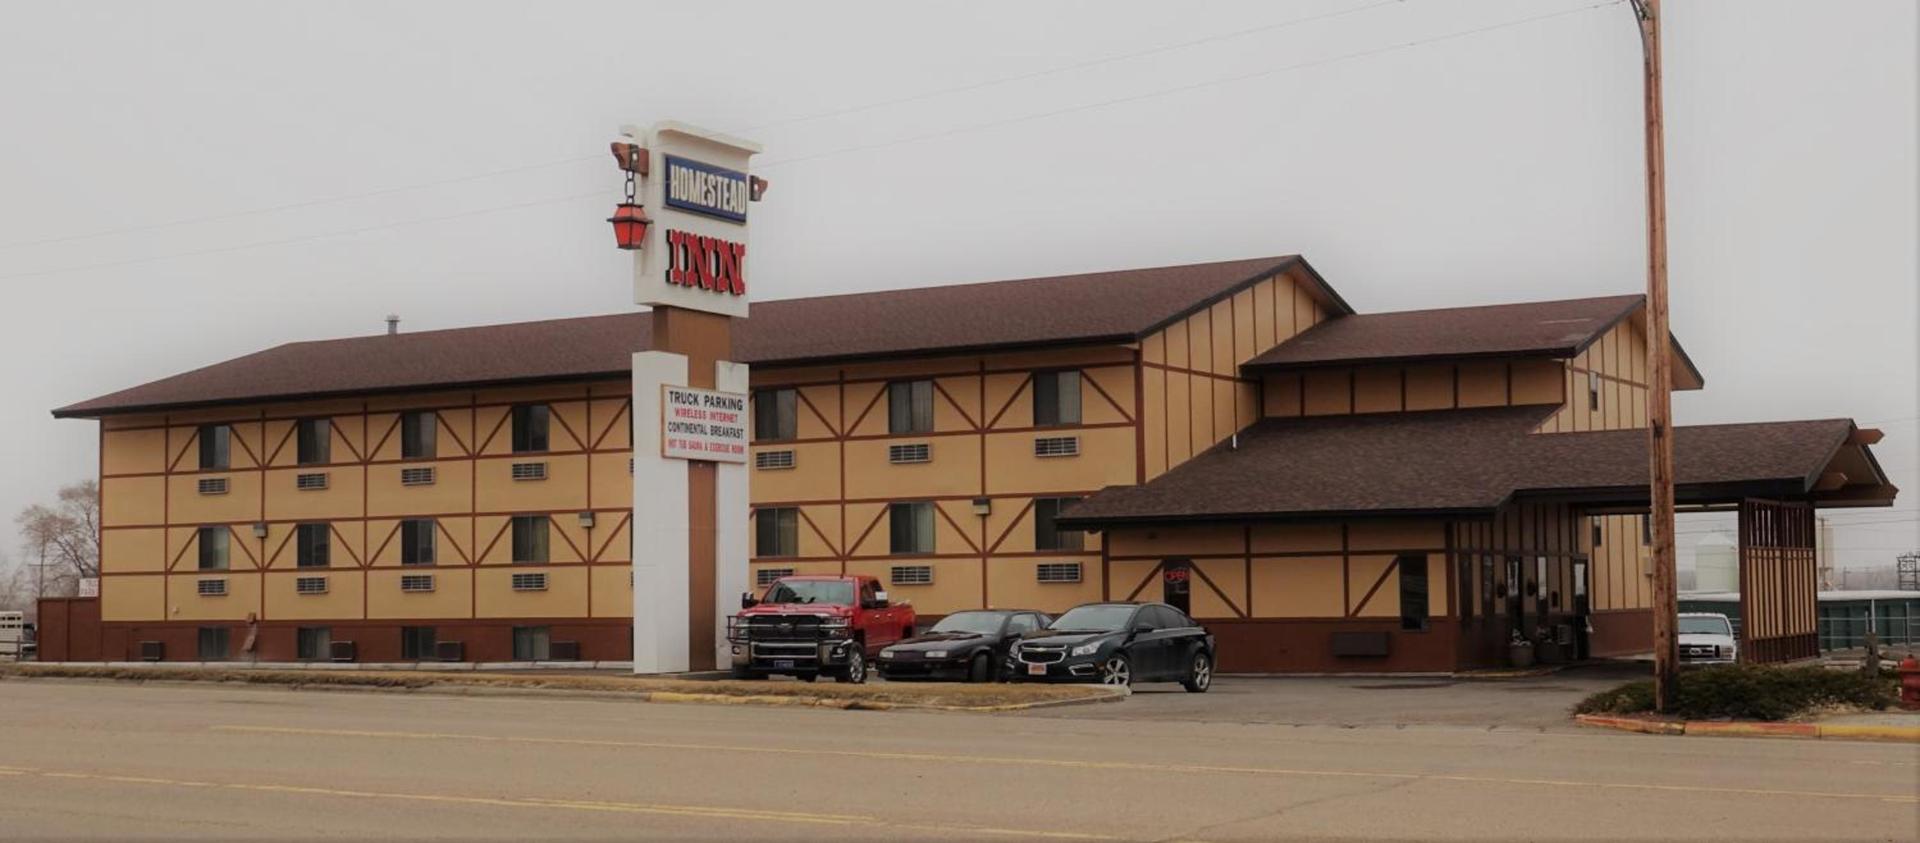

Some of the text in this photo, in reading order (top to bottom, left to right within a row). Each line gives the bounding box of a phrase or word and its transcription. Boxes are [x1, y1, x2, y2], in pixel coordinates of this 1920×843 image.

[670, 164, 746, 214] HOMESTEAD
[667, 229, 746, 296] INN
[669, 391, 743, 411] TRUCK PARKING
[674, 407, 738, 423] WIRELESS INTERNET
[668, 422, 744, 439] CONTINENTAL BREAKFAST
[1165, 570, 1189, 581] OPEN
